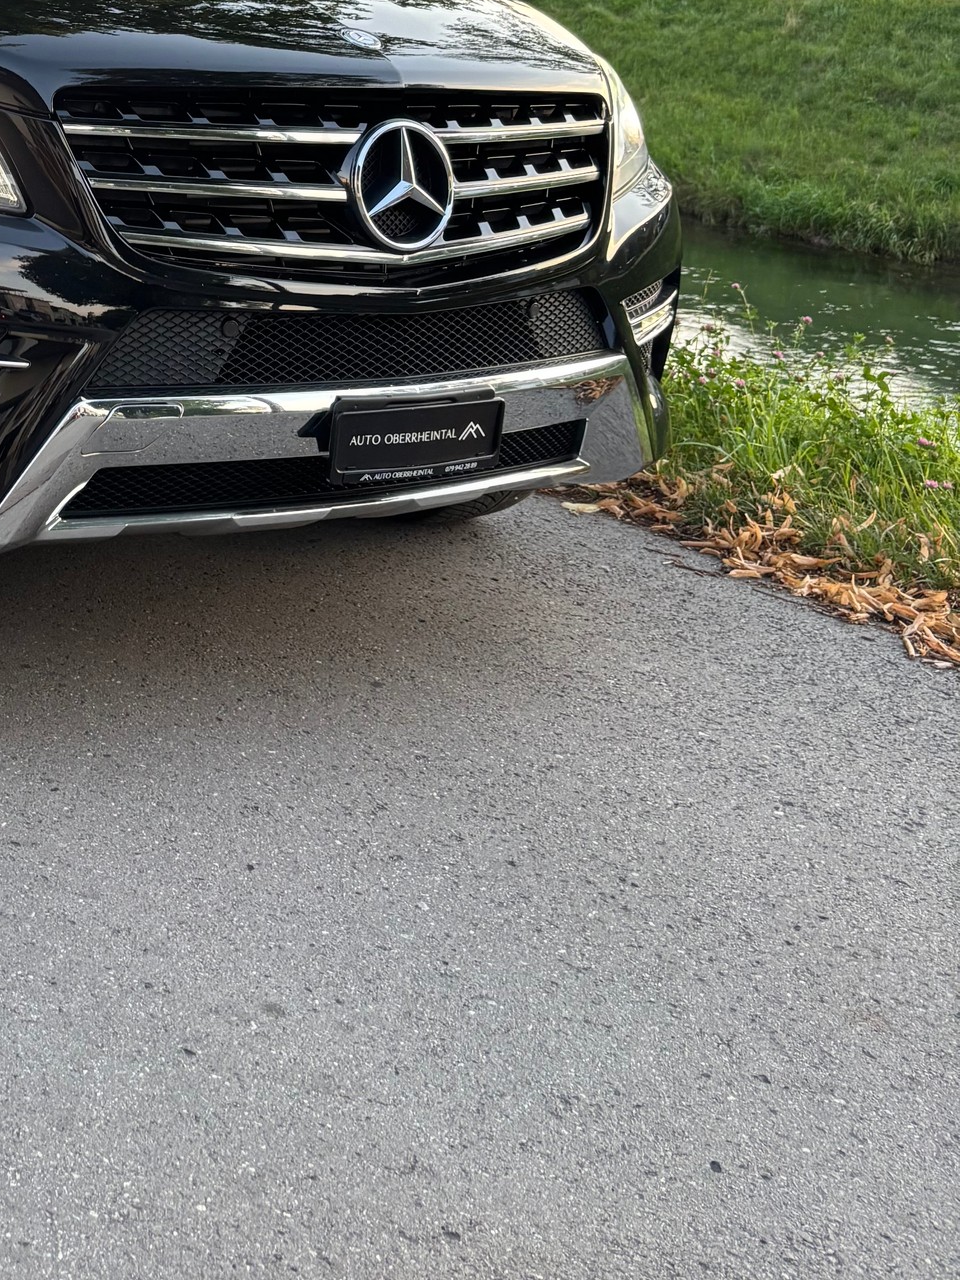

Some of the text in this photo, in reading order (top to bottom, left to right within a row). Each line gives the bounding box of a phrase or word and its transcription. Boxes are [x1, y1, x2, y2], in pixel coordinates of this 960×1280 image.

[349, 428, 457, 446] AUTO OBERRHEINTAL
[373, 472, 391, 480] AUTO
[392, 468, 434, 479] OBERRHEINTAL
